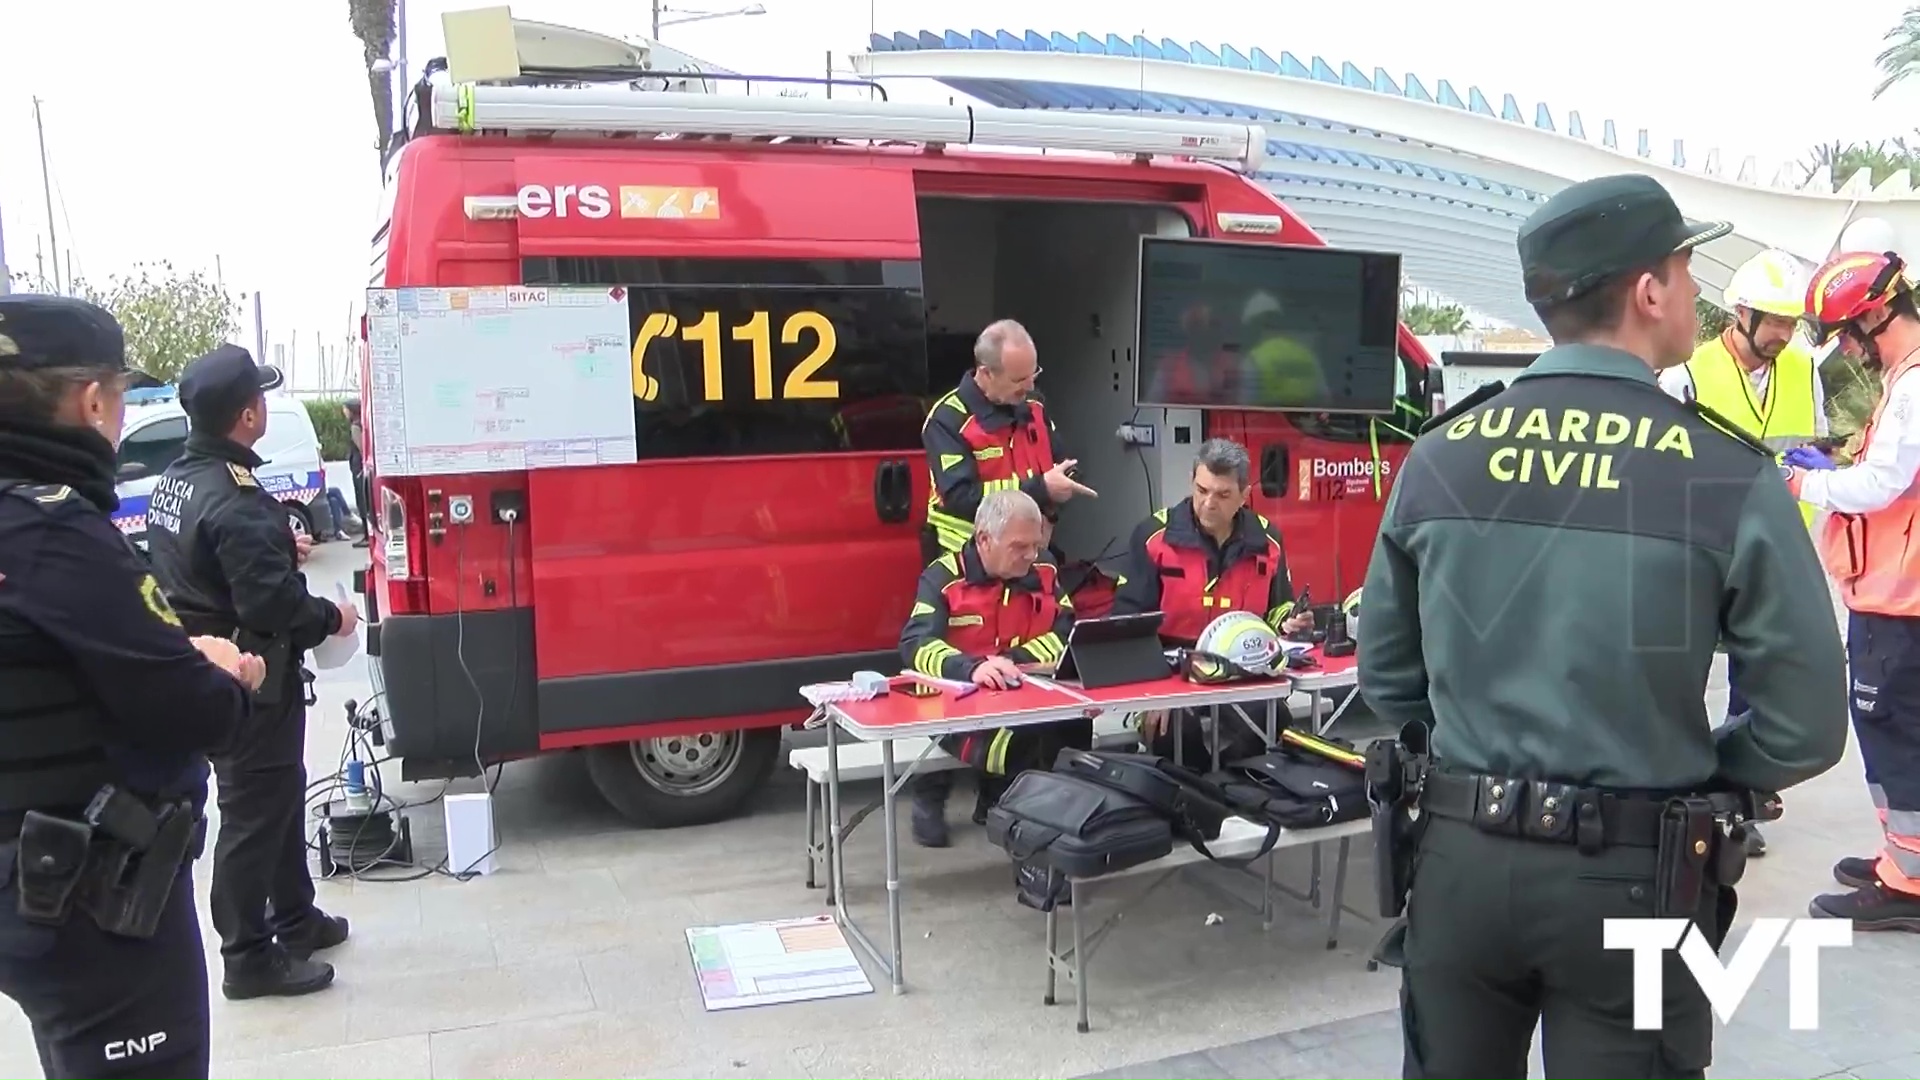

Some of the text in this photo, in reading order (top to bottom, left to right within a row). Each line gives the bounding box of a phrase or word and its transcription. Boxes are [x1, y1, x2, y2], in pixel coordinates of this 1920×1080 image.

[518, 184, 611, 218] ers
[508, 291, 546, 303] SITAC
[682, 311, 839, 400] 112
[1446, 407, 1694, 459] GUARDIA
[1488, 447, 1620, 489] CIVIL
[158, 475, 194, 501] OLICIA
[151, 491, 182, 516] LOCAL
[1242, 637, 1262, 651] 632
[105, 1031, 167, 1060] CNP
